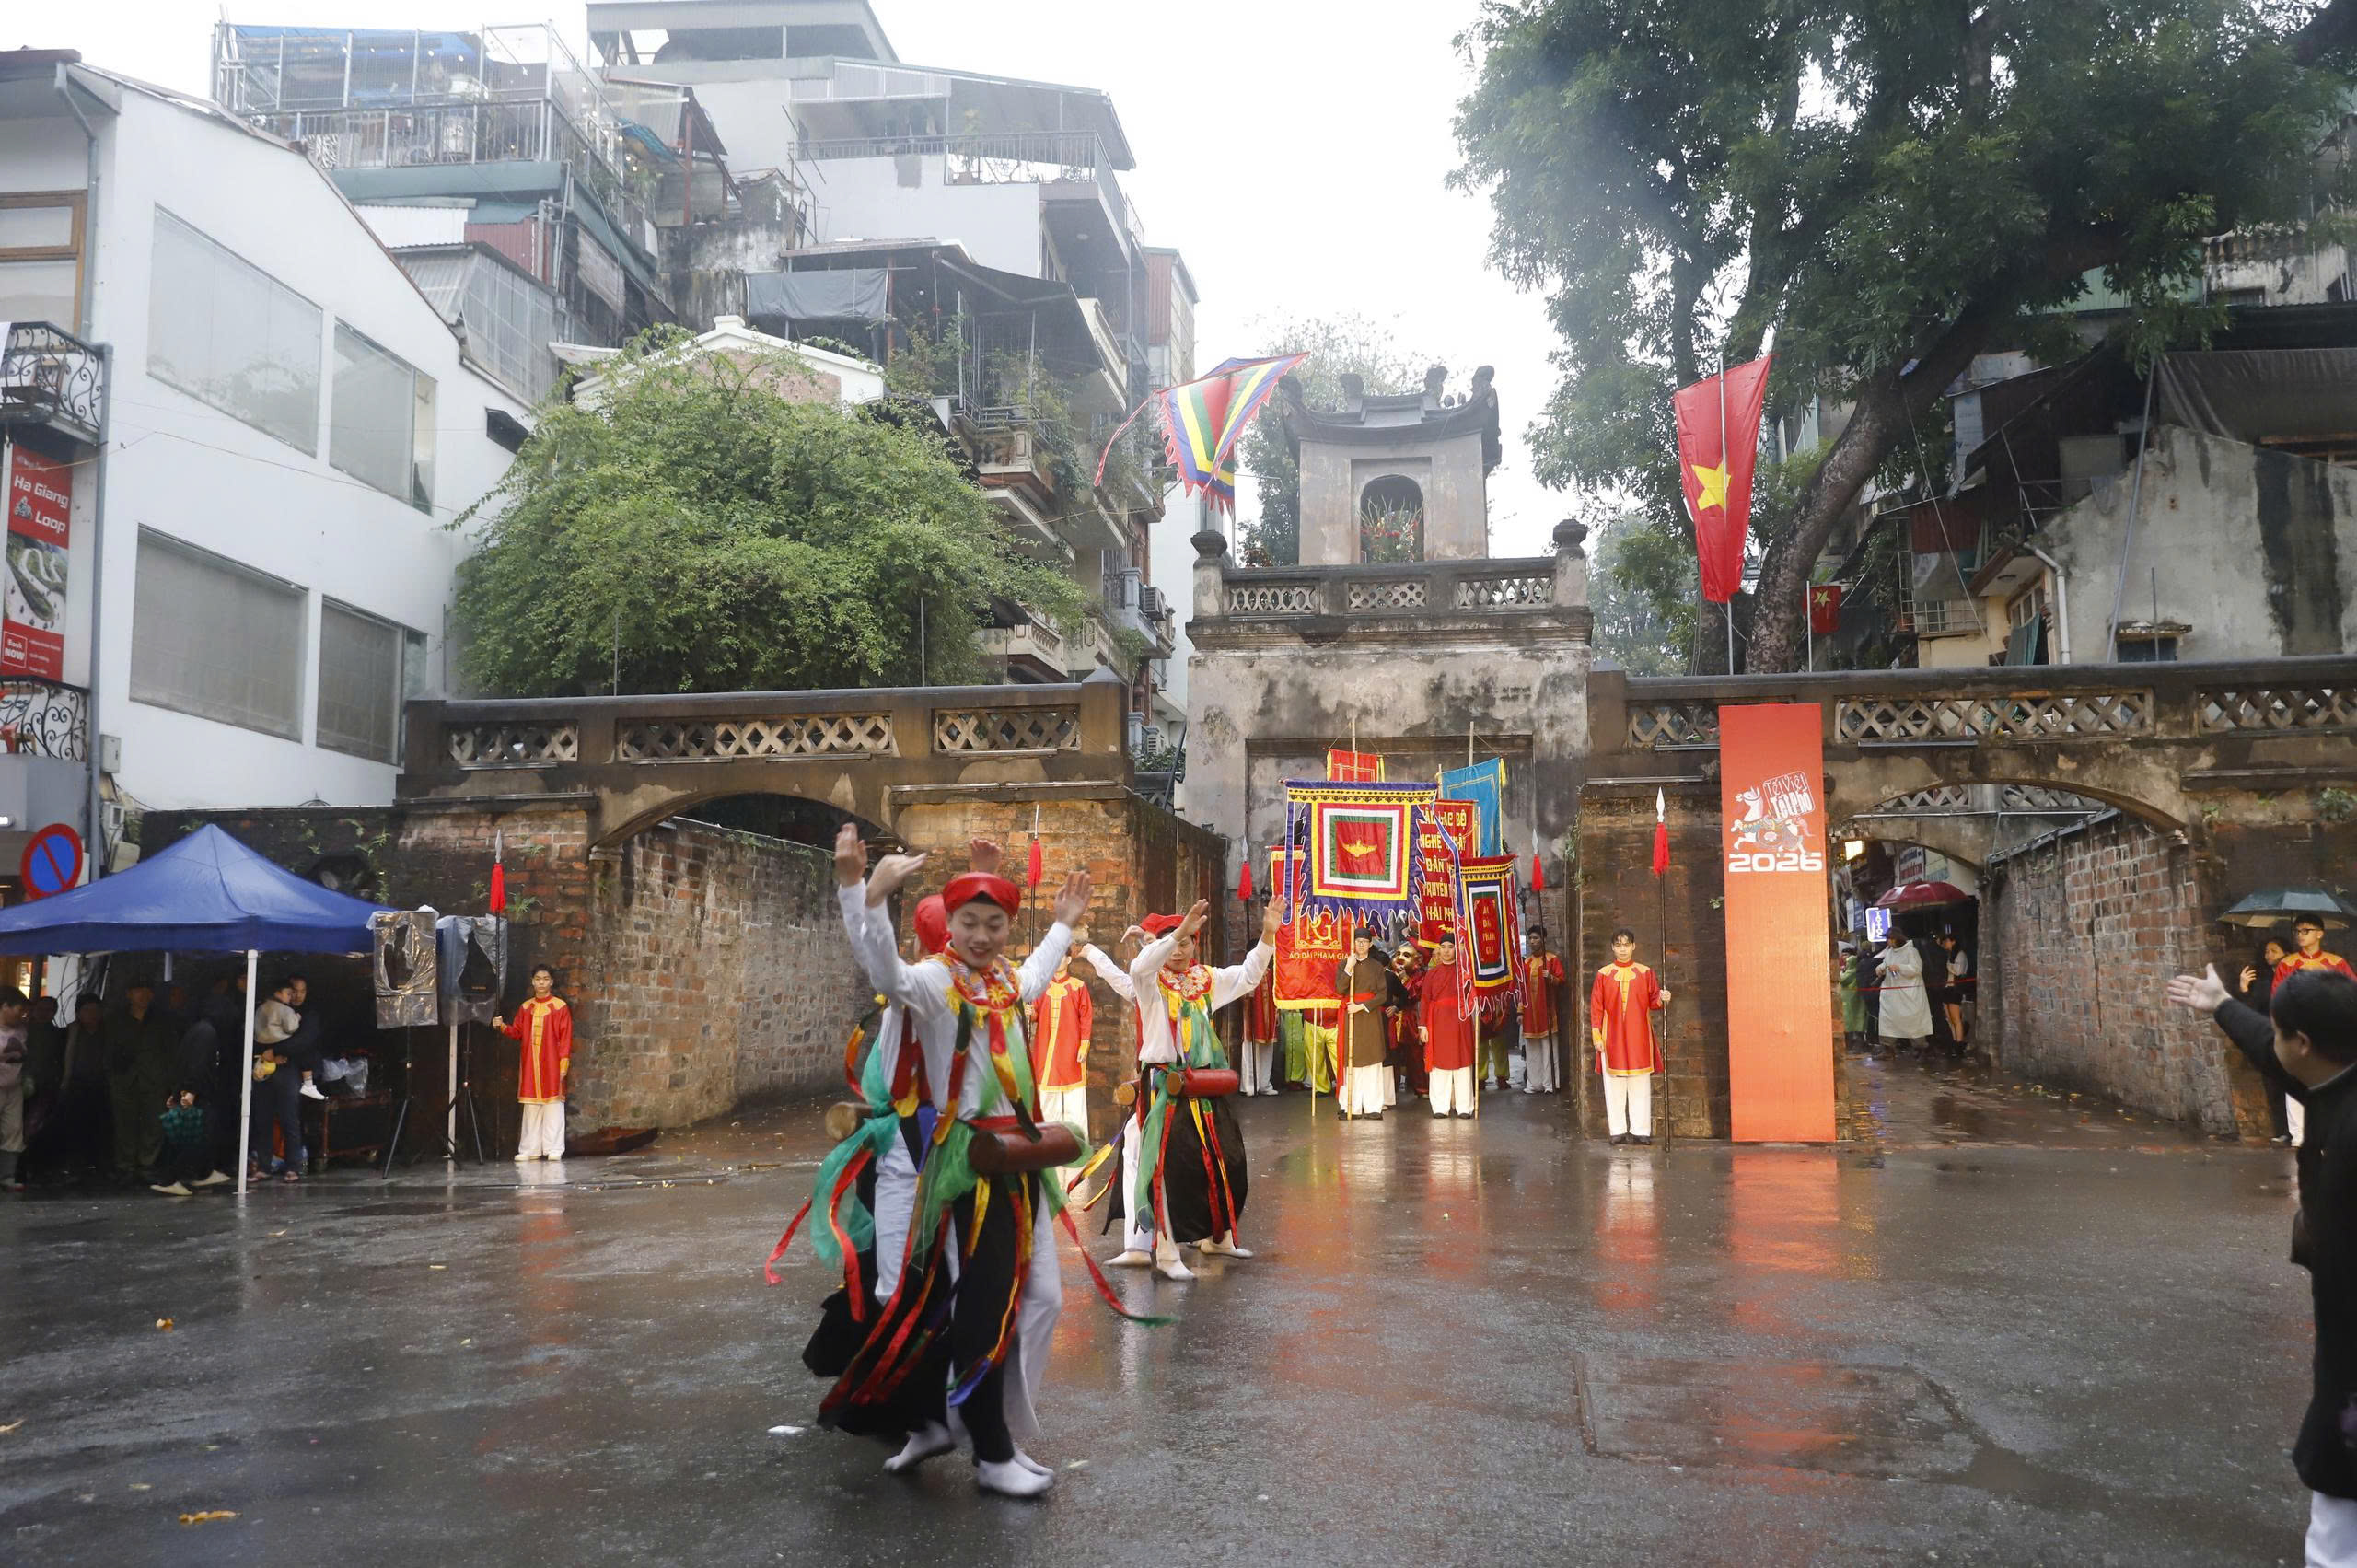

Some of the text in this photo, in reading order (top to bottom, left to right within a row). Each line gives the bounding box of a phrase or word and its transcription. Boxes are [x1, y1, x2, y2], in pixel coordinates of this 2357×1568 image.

[14, 475, 69, 509] Ha Giang
[35, 510, 66, 533] Loop
[5, 647, 25, 660] NOW
[1728, 853, 1823, 873] 2026
